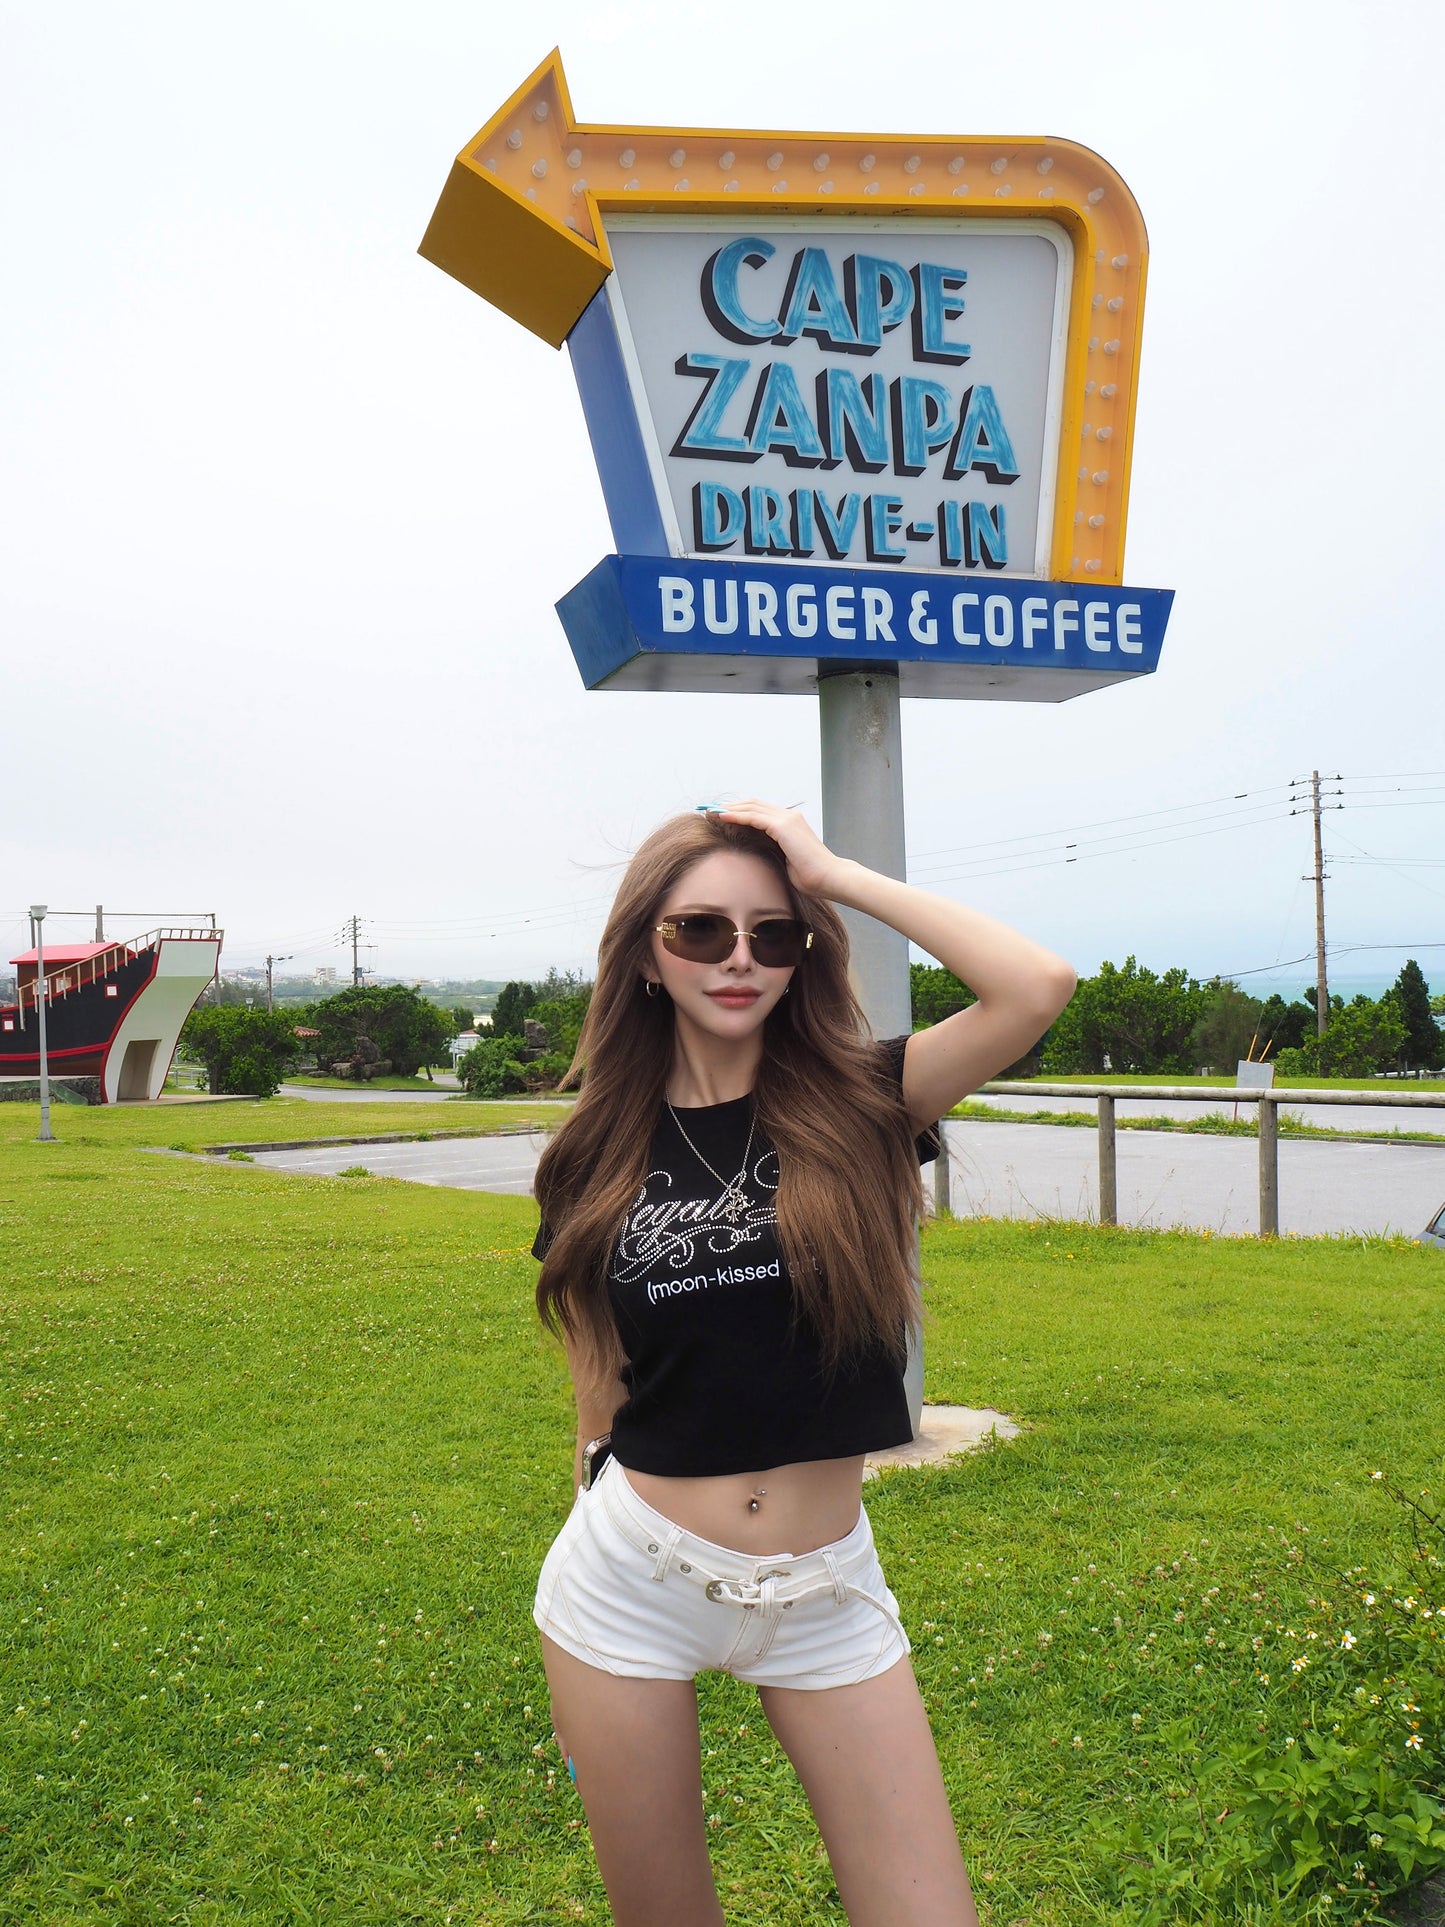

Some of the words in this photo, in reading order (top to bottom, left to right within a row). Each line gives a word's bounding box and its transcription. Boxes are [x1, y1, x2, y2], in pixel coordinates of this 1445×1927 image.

[701, 237, 971, 366] CAPE
[669, 353, 1021, 485] ZANPA
[693, 482, 1008, 569] DRIVE-IN
[658, 576, 897, 642] BURGER
[908, 590, 938, 645] &
[952, 593, 1144, 654] COFFEE
[647, 1259, 780, 1304] (moon-kissed
